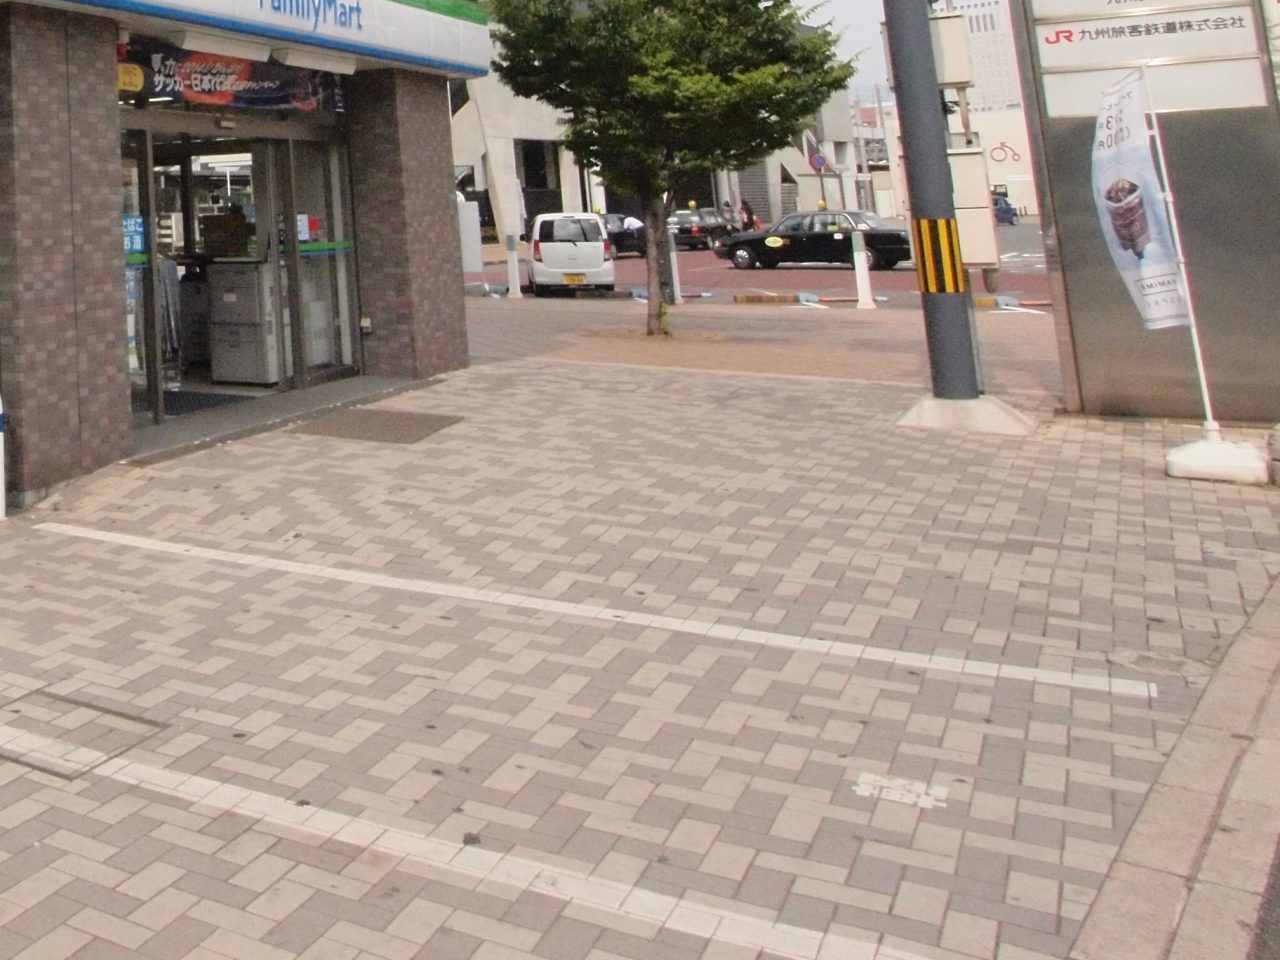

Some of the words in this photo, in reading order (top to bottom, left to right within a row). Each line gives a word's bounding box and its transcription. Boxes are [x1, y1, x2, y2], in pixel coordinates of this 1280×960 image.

[1045, 30, 1074, 45] JR
[1078, 15, 1246, 41] 九州旅客鉄道株式会社
